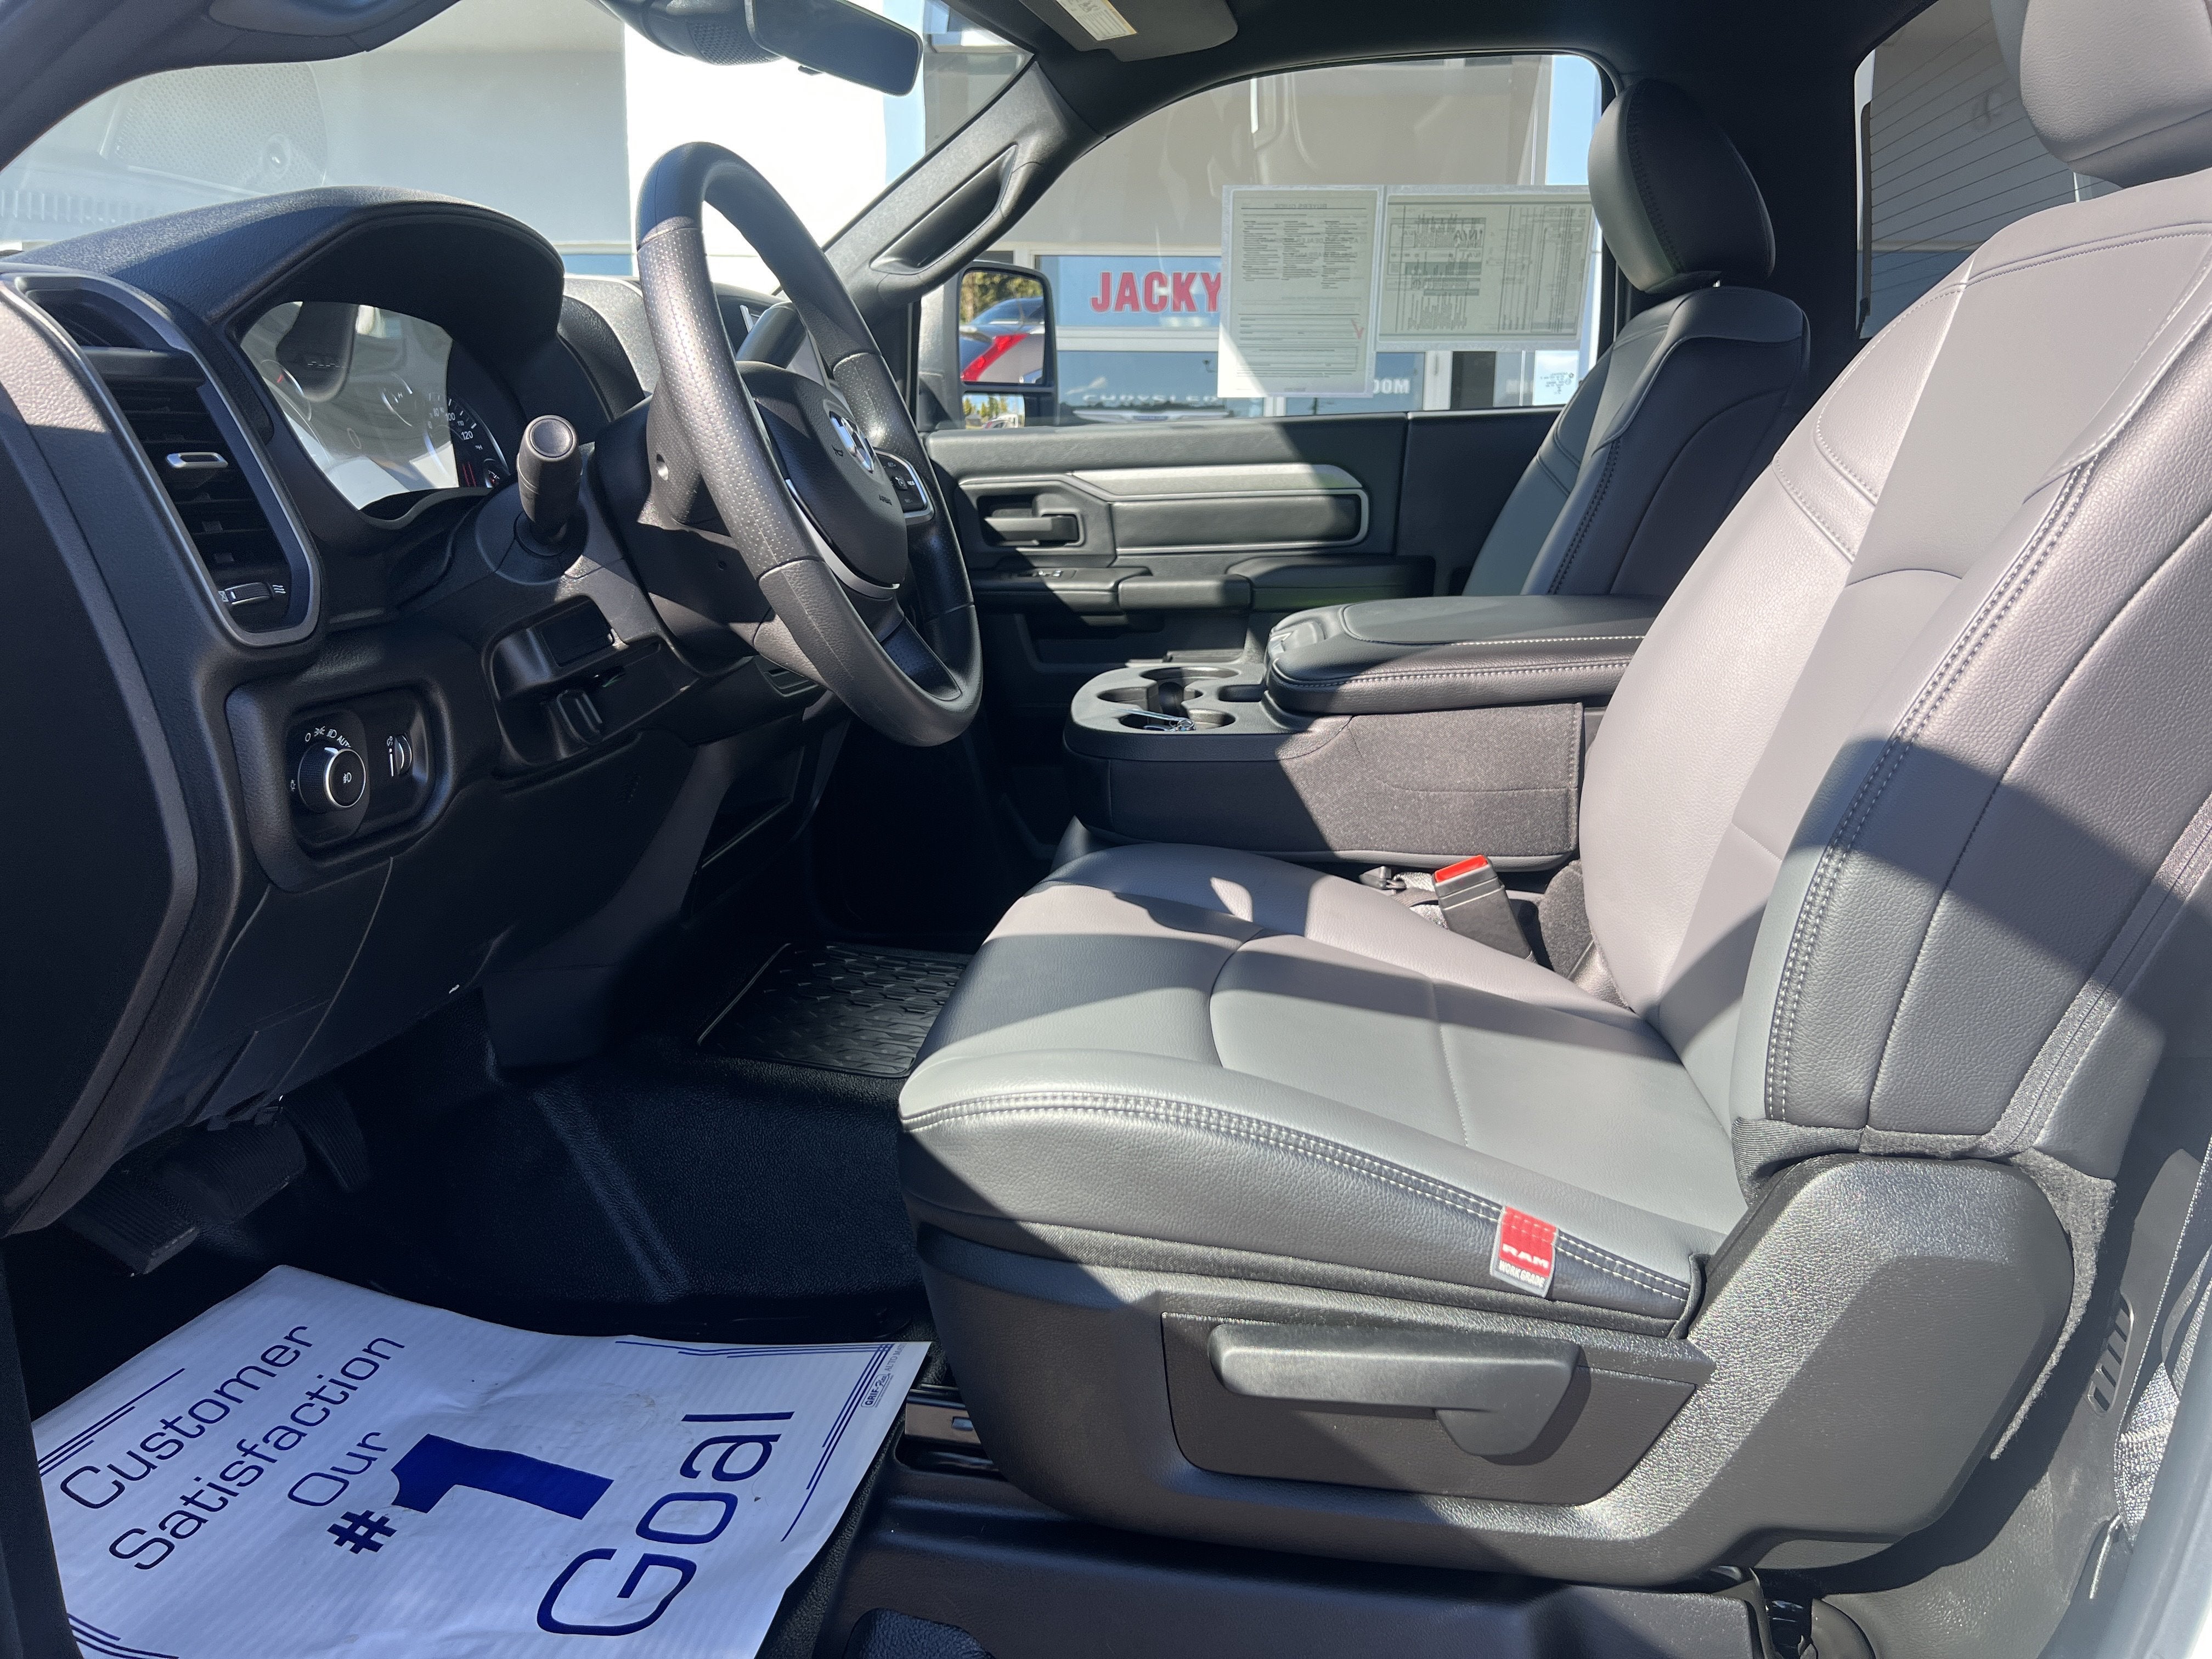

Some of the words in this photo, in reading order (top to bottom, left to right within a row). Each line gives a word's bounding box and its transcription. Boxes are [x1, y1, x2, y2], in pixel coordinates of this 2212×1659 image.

[1090, 271, 1222, 312] JACKY
[445, 412, 456, 421] 100
[461, 430, 473, 440] 120
[336, 735, 352, 748] AUT
[1502, 1243, 1549, 1269] RAM
[1499, 1260, 1521, 1280] WORK
[1520, 1269, 1546, 1288] GRADE
[60, 1325, 313, 1509] Customer
[109, 1336, 405, 1570] Satisfaction
[287, 1432, 388, 1506] Our
[537, 1411, 795, 1636] Goal
